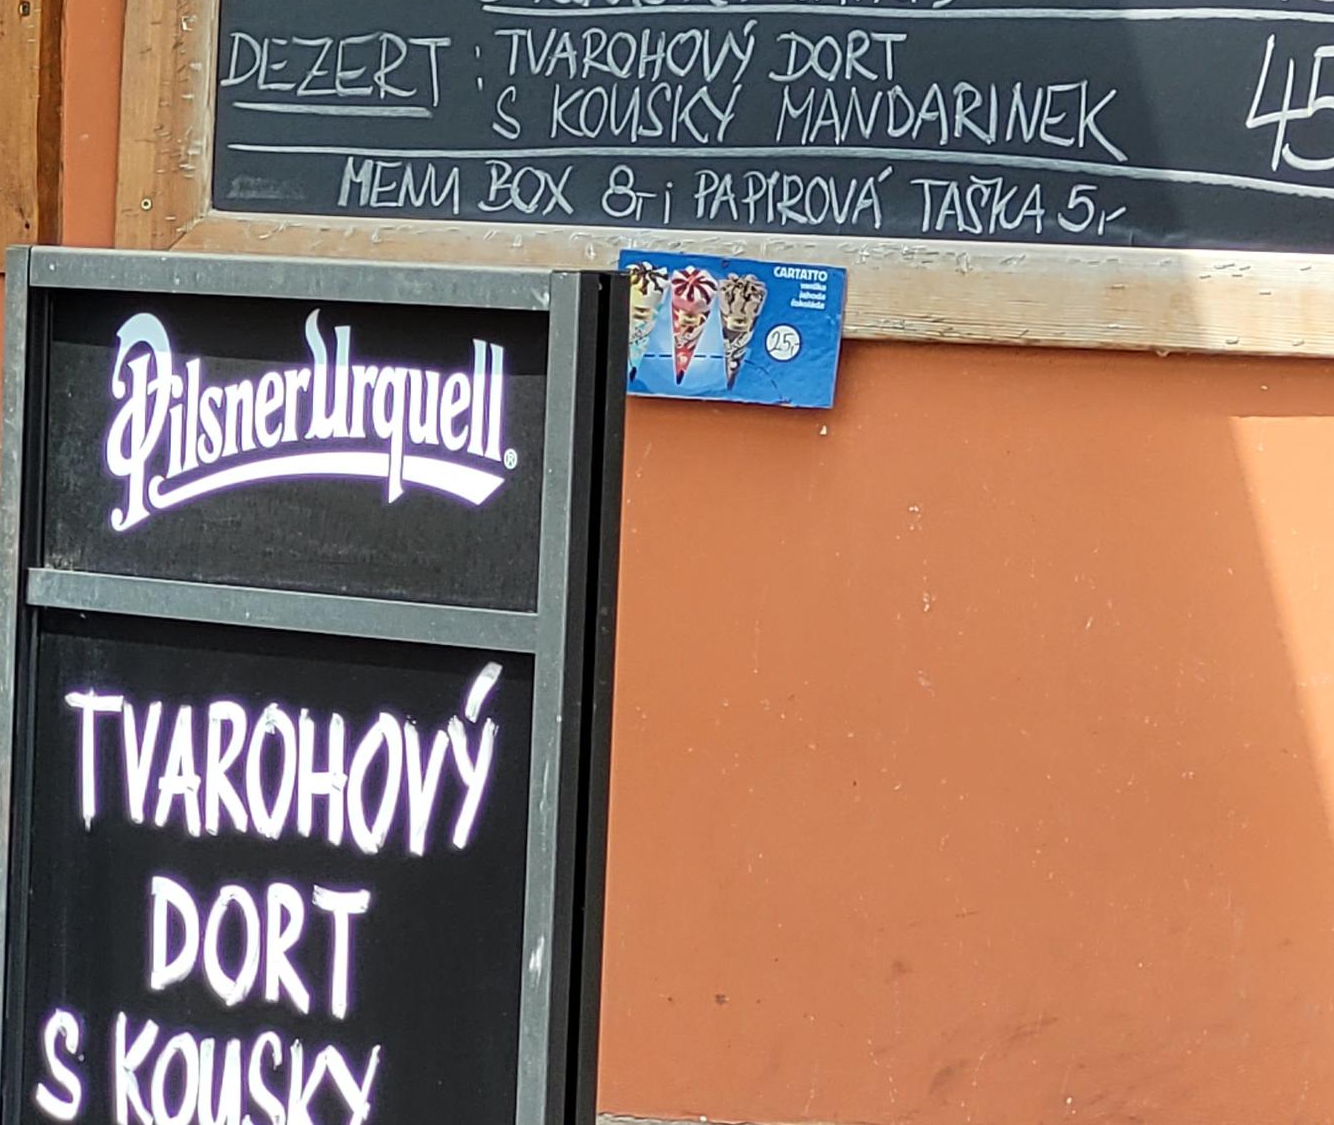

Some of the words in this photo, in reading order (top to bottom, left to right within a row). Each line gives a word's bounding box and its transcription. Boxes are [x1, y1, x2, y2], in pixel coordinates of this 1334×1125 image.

[494, 19, 758, 82] TVAROHOVÝ
[768, 31, 907, 81] DORT
[493, 85, 522, 141] S
[549, 82, 743, 146] KOUSKY
[777, 79, 1128, 161] MANDARINEK
[338, 155, 461, 217] MENU
[478, 159, 575, 217] BOX
[694, 165, 893, 230] PAPÍROVÁ
[910, 175, 1046, 235] TAŠKA
[64, 661, 504, 857] TVAROHOVÝ
[149, 874, 371, 1021] DORT
[35, 1007, 83, 1123] S
[115, 1011, 383, 1125] KOUSKY
